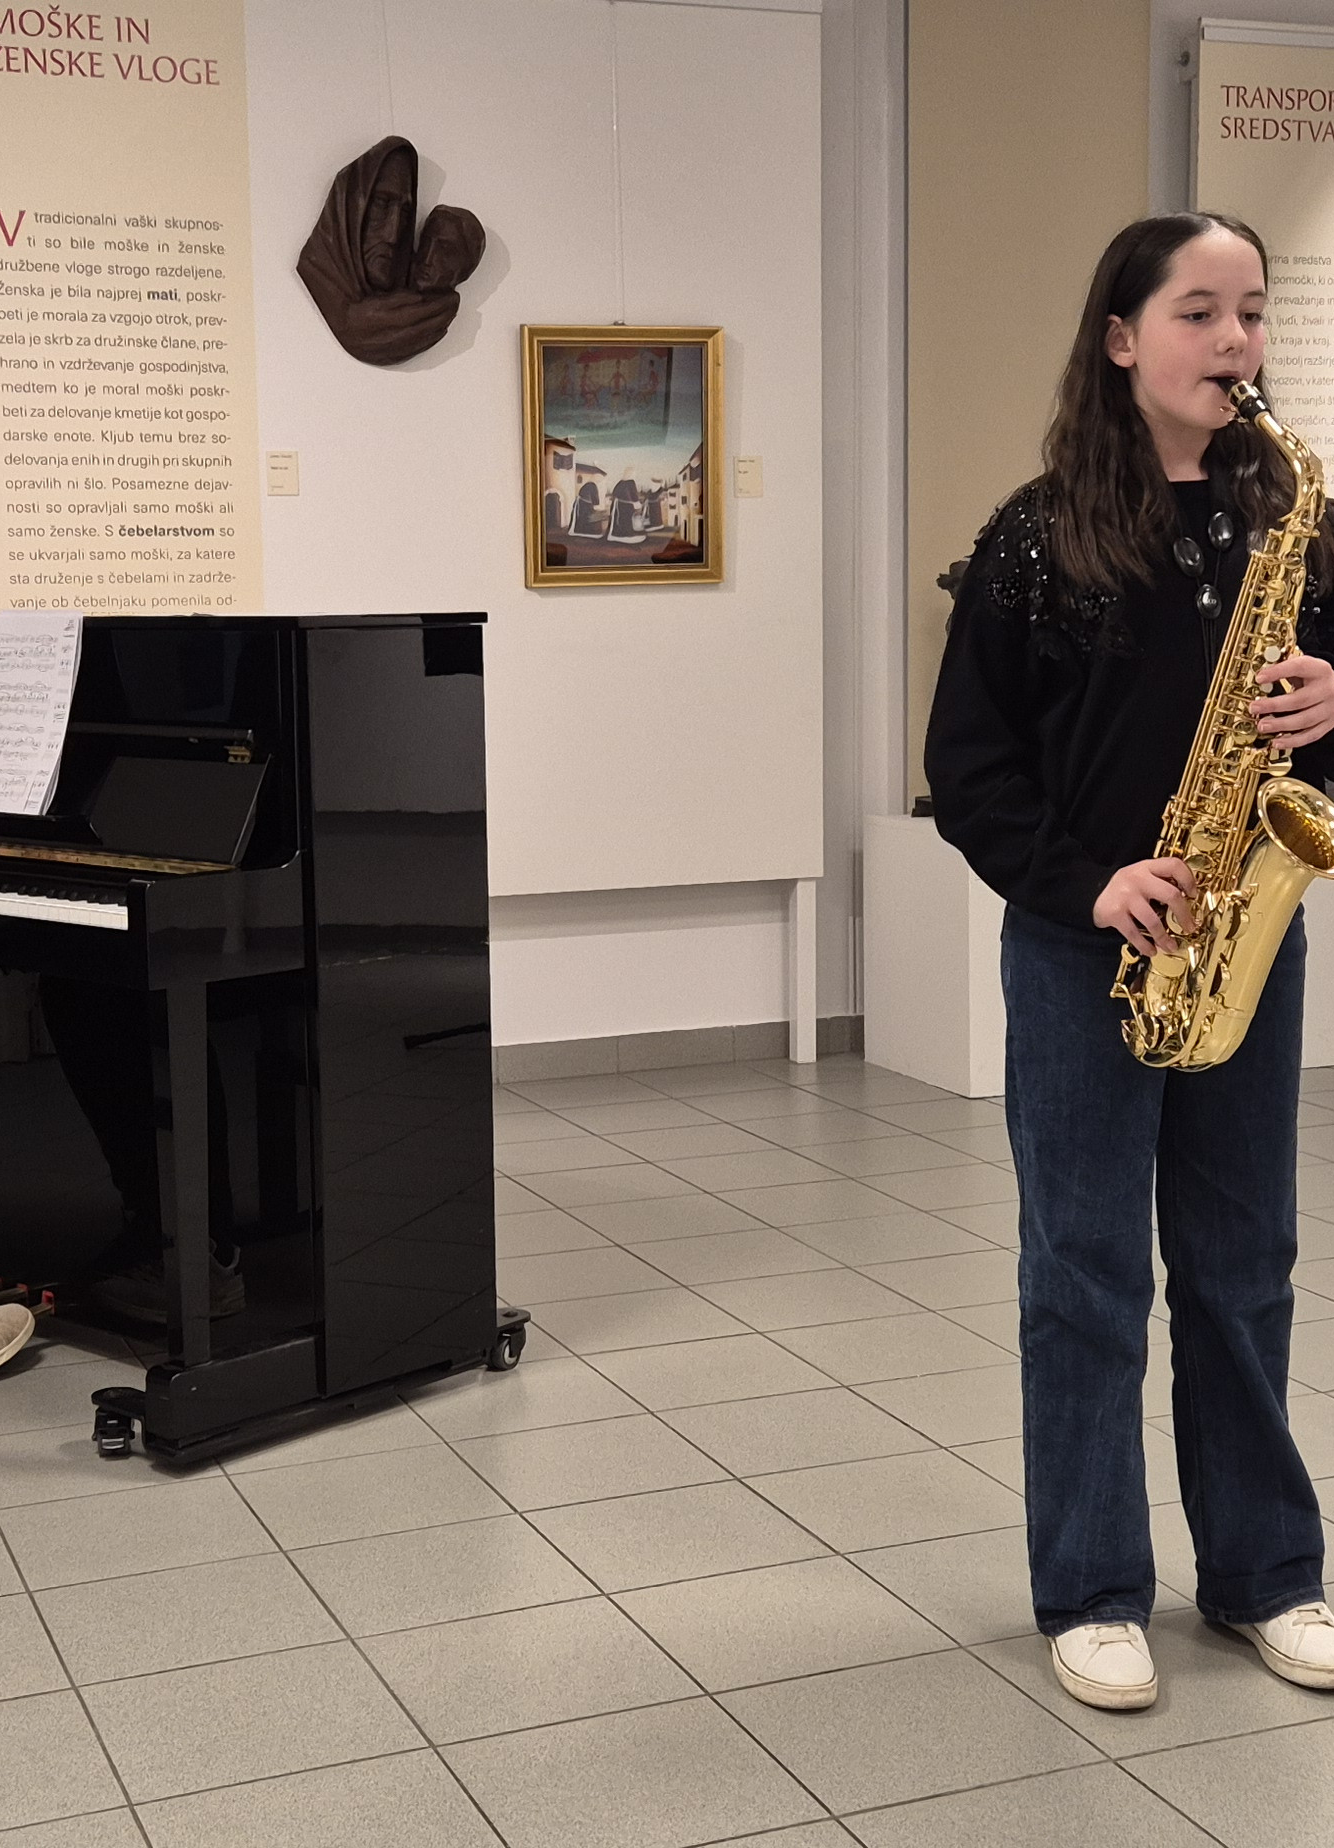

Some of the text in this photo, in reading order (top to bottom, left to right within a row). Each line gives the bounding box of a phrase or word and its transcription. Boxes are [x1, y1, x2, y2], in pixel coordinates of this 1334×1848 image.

[115, 17, 149, 44] IN
[113, 53, 219, 85] VLOGE
[34, 212, 116, 226] tradicionalni
[124, 215, 157, 228] vaški
[165, 217, 223, 232] skupnos-
[27, 236, 225, 255] ti so bile moške in ženske
[65, 261, 102, 277] vloge
[108, 264, 150, 279] strogo
[50, 285, 62, 299] je
[68, 285, 91, 298] bila
[97, 288, 142, 302] najprej
[147, 288, 181, 302] mati,
[186, 290, 226, 304] poskr-
[27, 309, 38, 323] je
[42, 310, 88, 322] morala
[91, 313, 106, 323] za
[109, 314, 152, 326] vzgojo
[156, 313, 192, 326] otrok,
[196, 316, 227, 328] prev-
[0, 332, 227, 352] zela je skrb za družinske člane, pre-
[0, 357, 228, 375] hrano in vzdrževanje gospodinjstva,
[1, 381, 230, 398] medtem ko je moral moški poskr-
[2, 405, 230, 423] beti za delovanje kmetije kot gospo-
[3, 429, 231, 445] darske enote. Kljub temu brez so-
[4, 453, 232, 469] delovanja enih in drugih pri skupnih
[5, 477, 232, 493] opravilih ni šlo. Posamezne dejav-
[7, 501, 234, 516] nosti so opravljali samo moški ali
[8, 524, 235, 537] samo ženske. S čebelarstvom so
[9, 548, 235, 563] se ukvarjali samo moški, za katere
[10, 571, 236, 587] sta druženje s čebelami in zadrže-
[10, 595, 236, 610] vanje ob čebelnjaku pomenila od-
